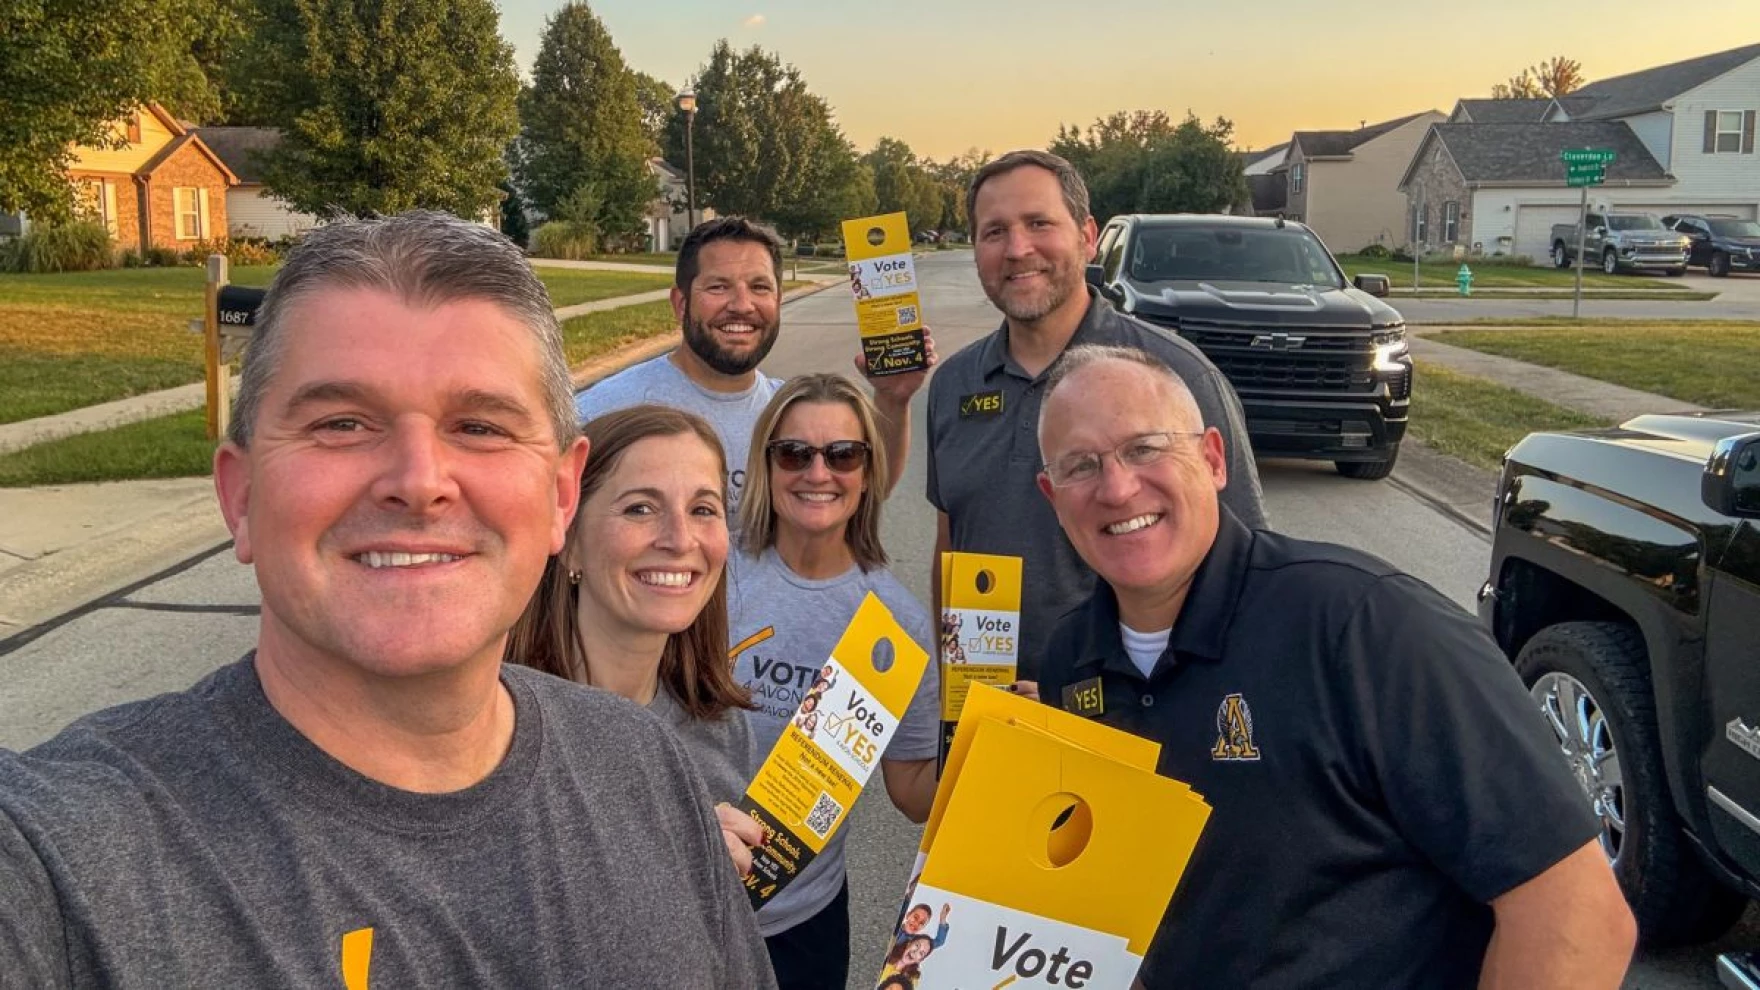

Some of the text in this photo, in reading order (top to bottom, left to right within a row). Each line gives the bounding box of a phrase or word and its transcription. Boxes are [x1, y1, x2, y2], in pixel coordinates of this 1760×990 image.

[874, 259, 906, 273] Vote
[884, 272, 912, 285] YES
[219, 310, 249, 324] 1687
[884, 357, 912, 368] Nov.
[914, 351, 923, 362] 4
[974, 395, 1000, 412] YES
[976, 615, 1012, 633] Vote
[984, 636, 1014, 652] YES
[1075, 687, 1098, 711] YES
[847, 689, 884, 737] Vote
[843, 722, 878, 764] YES
[760, 883, 777, 899] 4
[991, 924, 1094, 989] Vote
